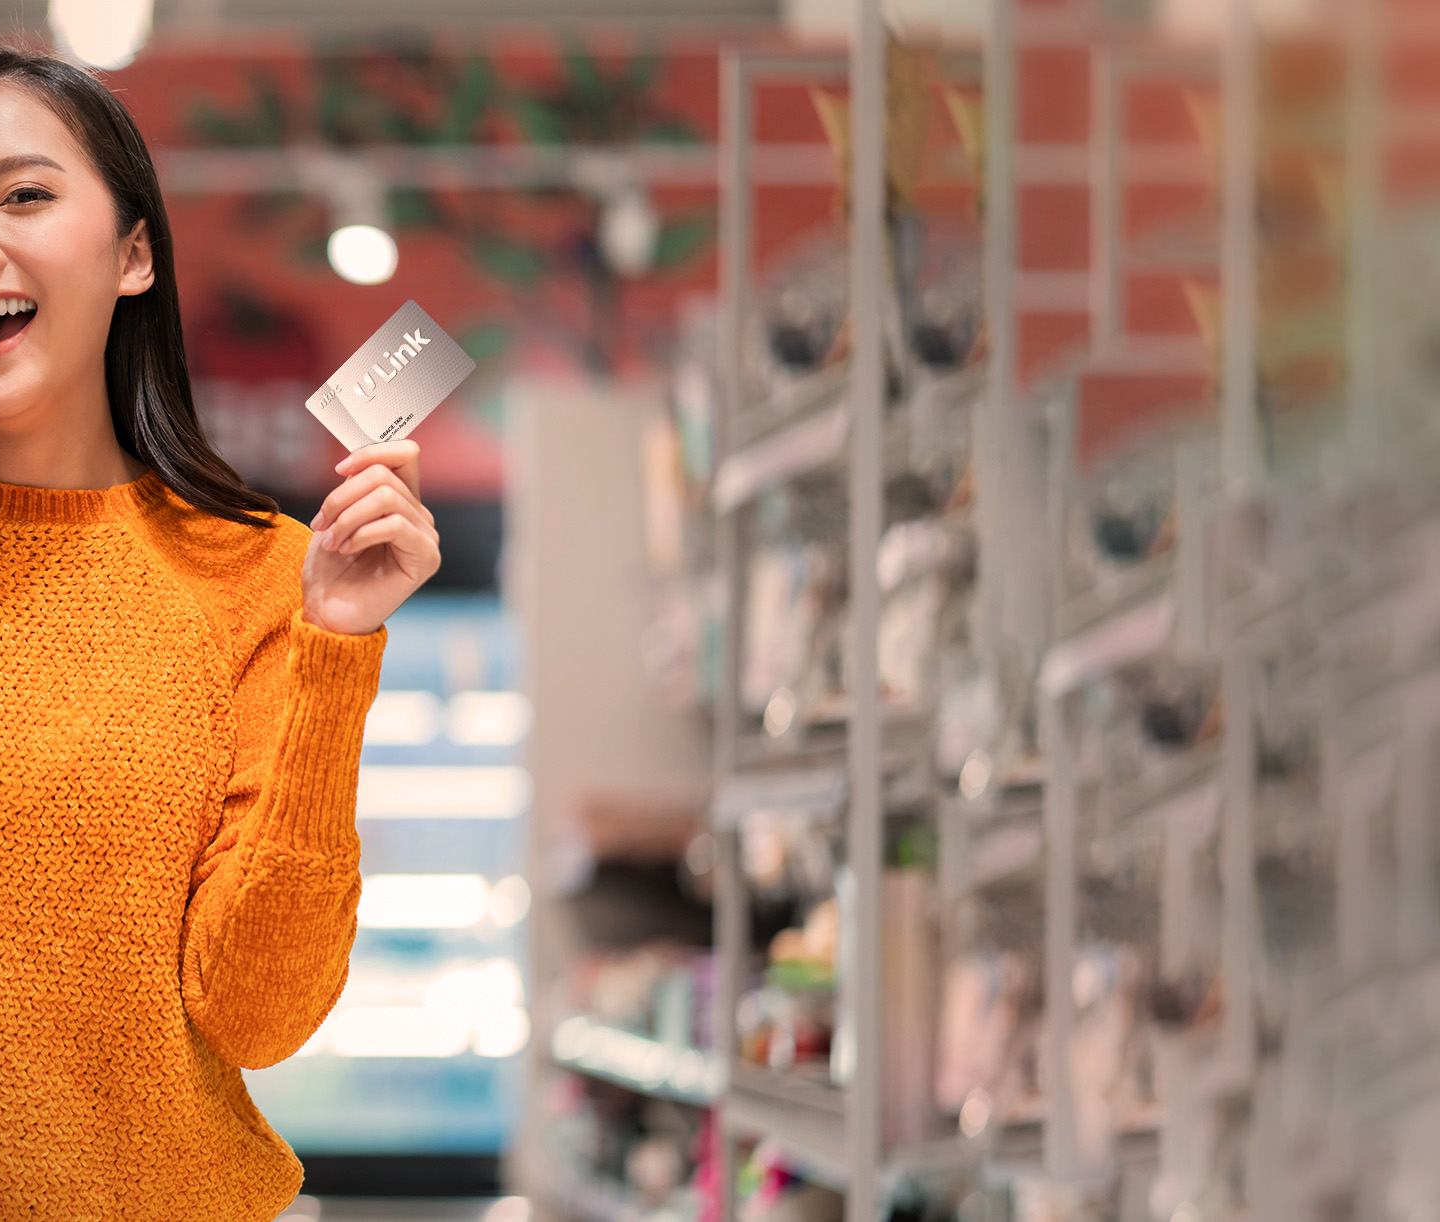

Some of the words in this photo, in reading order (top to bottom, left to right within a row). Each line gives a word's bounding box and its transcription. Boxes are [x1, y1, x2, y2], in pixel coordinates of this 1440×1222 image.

[372, 327, 432, 383] Link
[380, 424, 395, 439] GRACE
[394, 416, 403, 425] TAN
